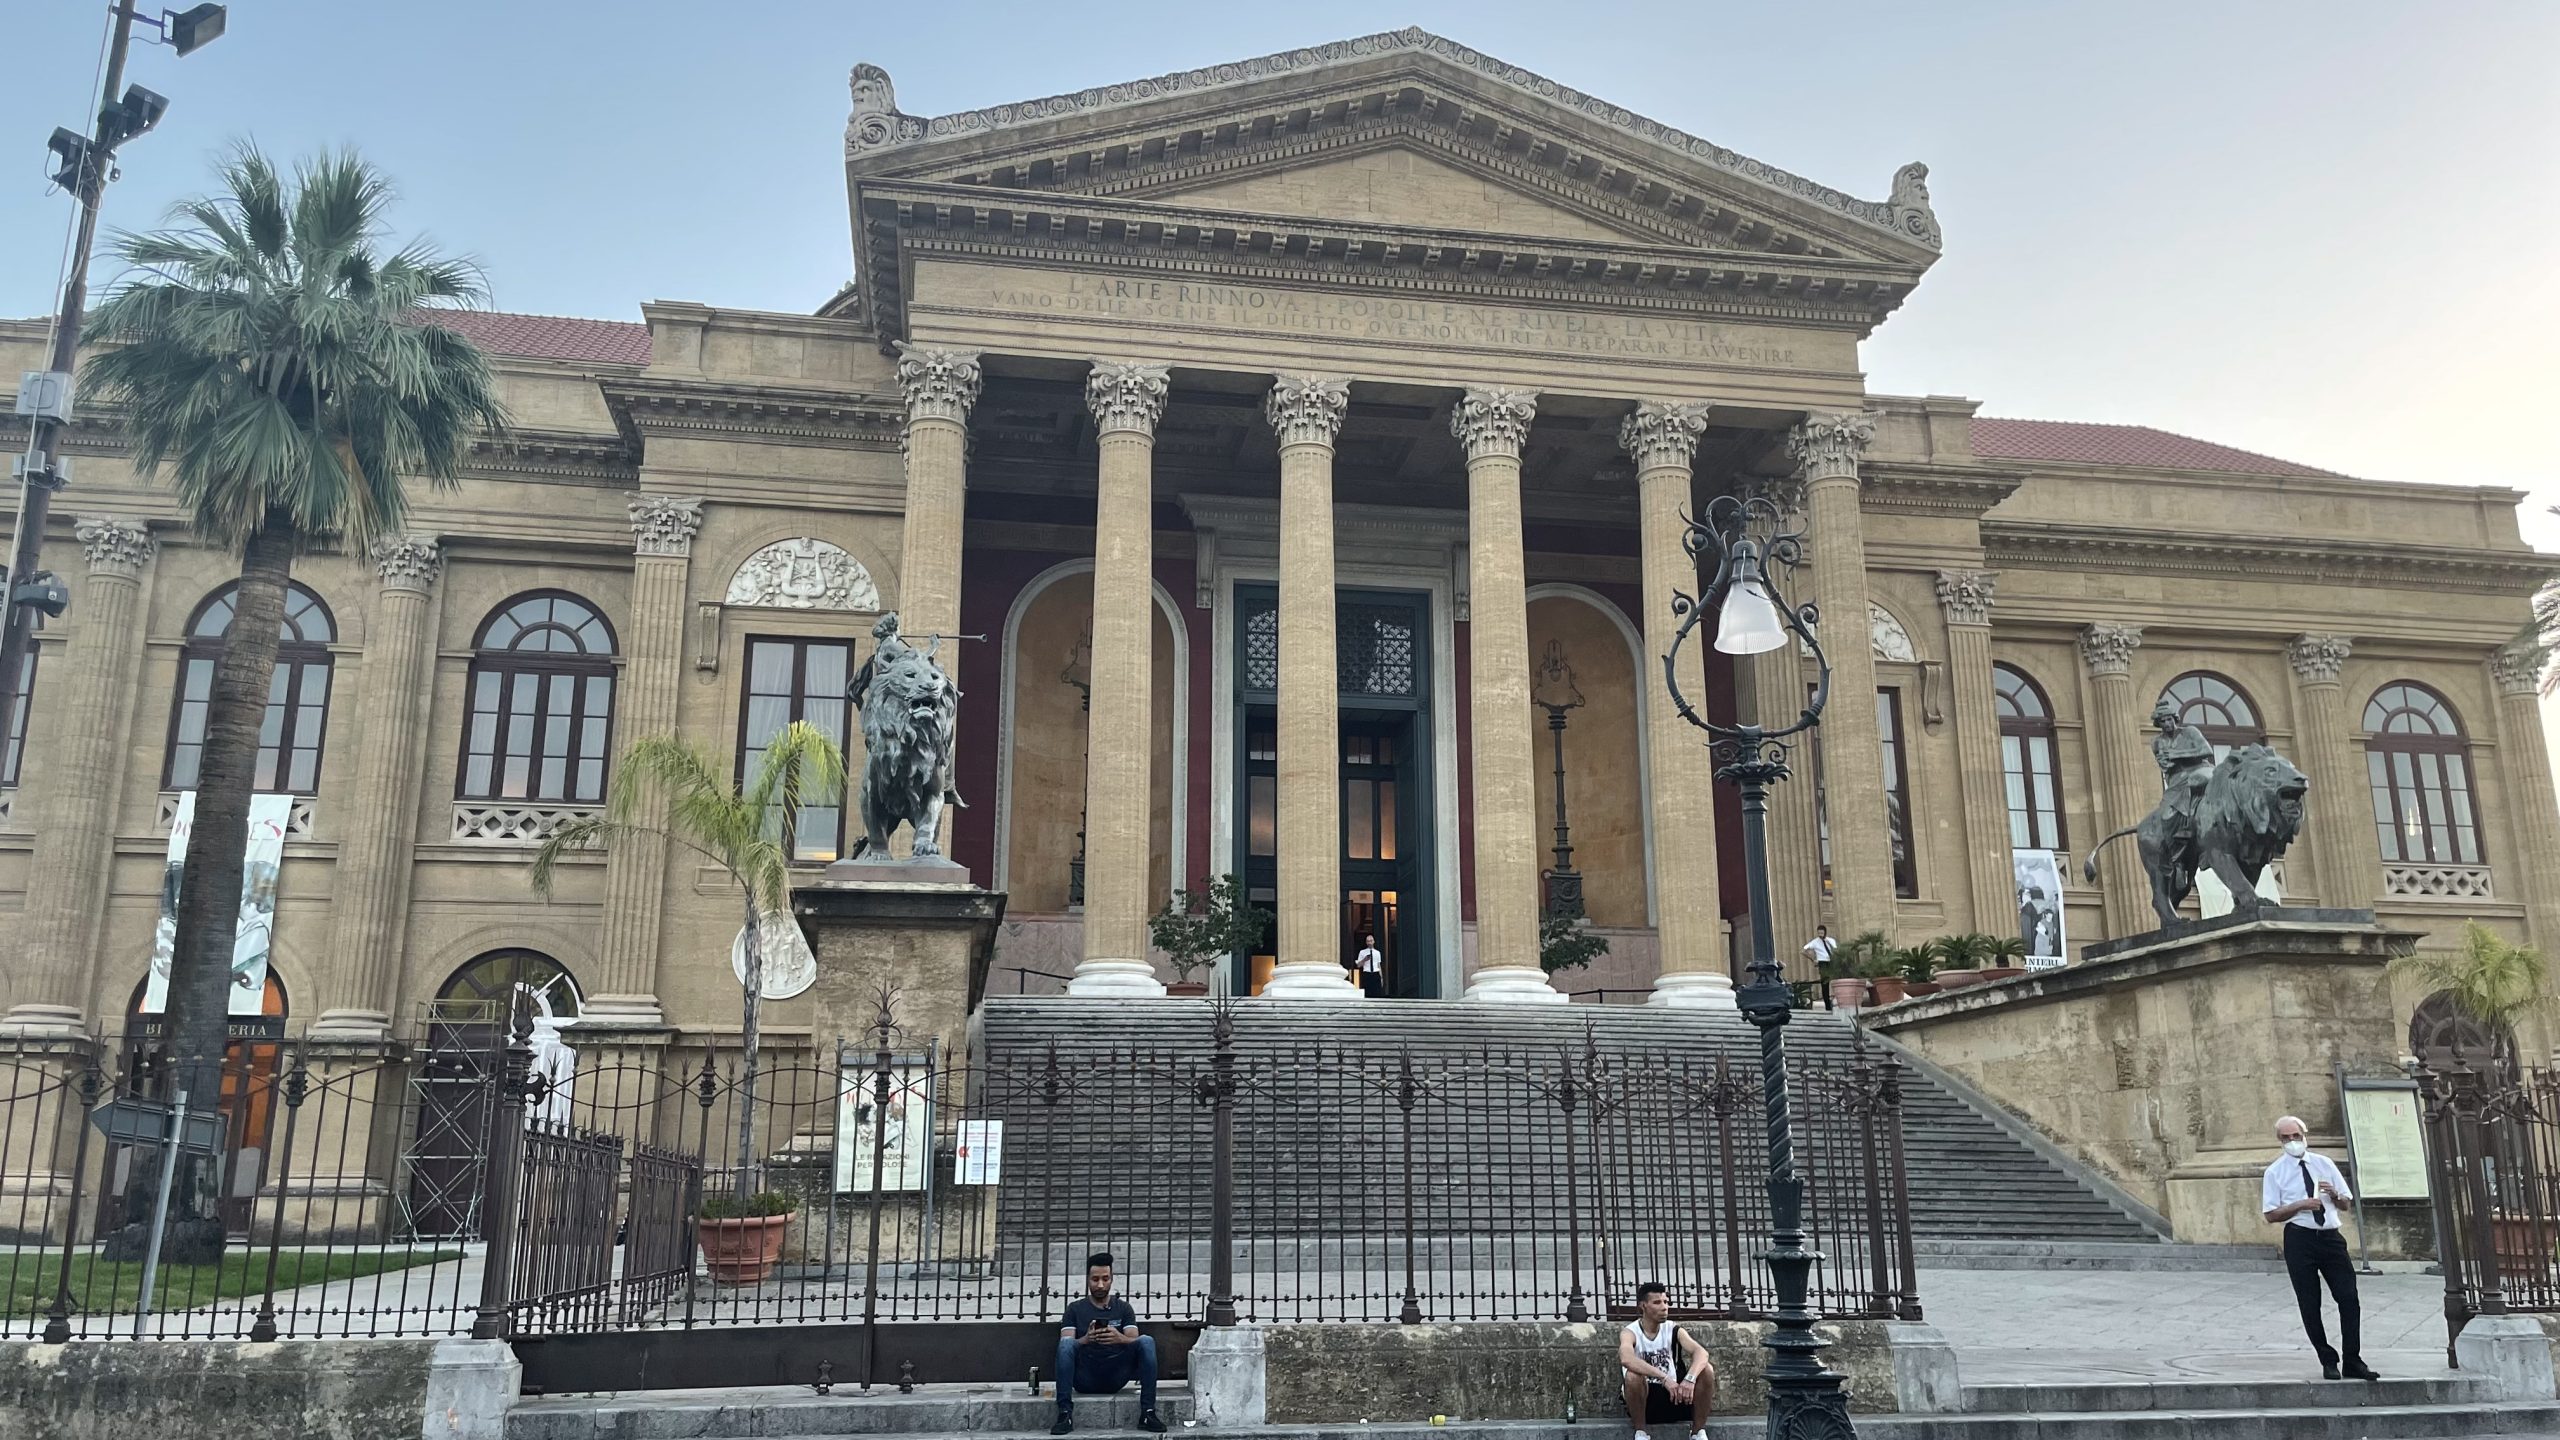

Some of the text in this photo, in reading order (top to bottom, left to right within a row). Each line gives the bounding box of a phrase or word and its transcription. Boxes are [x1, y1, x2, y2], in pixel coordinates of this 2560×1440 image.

[992, 290, 1052, 307] VANO
[1066, 296, 1127, 314] DELLE
[1145, 302, 1217, 321] SCENE
[1266, 311, 1351, 331] DILETTO
[1369, 319, 1407, 336] OVE
[1424, 324, 1467, 339] NON
[1485, 328, 1532, 344] MIRI
[1567, 335, 1670, 354] PREPARAR
[1179, 285, 1299, 312] RINNOVA
[1338, 299, 1426, 321] POPOLI
[1443, 306, 1456, 323] E
[1470, 308, 1500, 327] NE
[1519, 312, 1608, 335] RIVELA
[1625, 319, 1652, 338] LA
[146, 1023, 267, 1036] BIERIA
